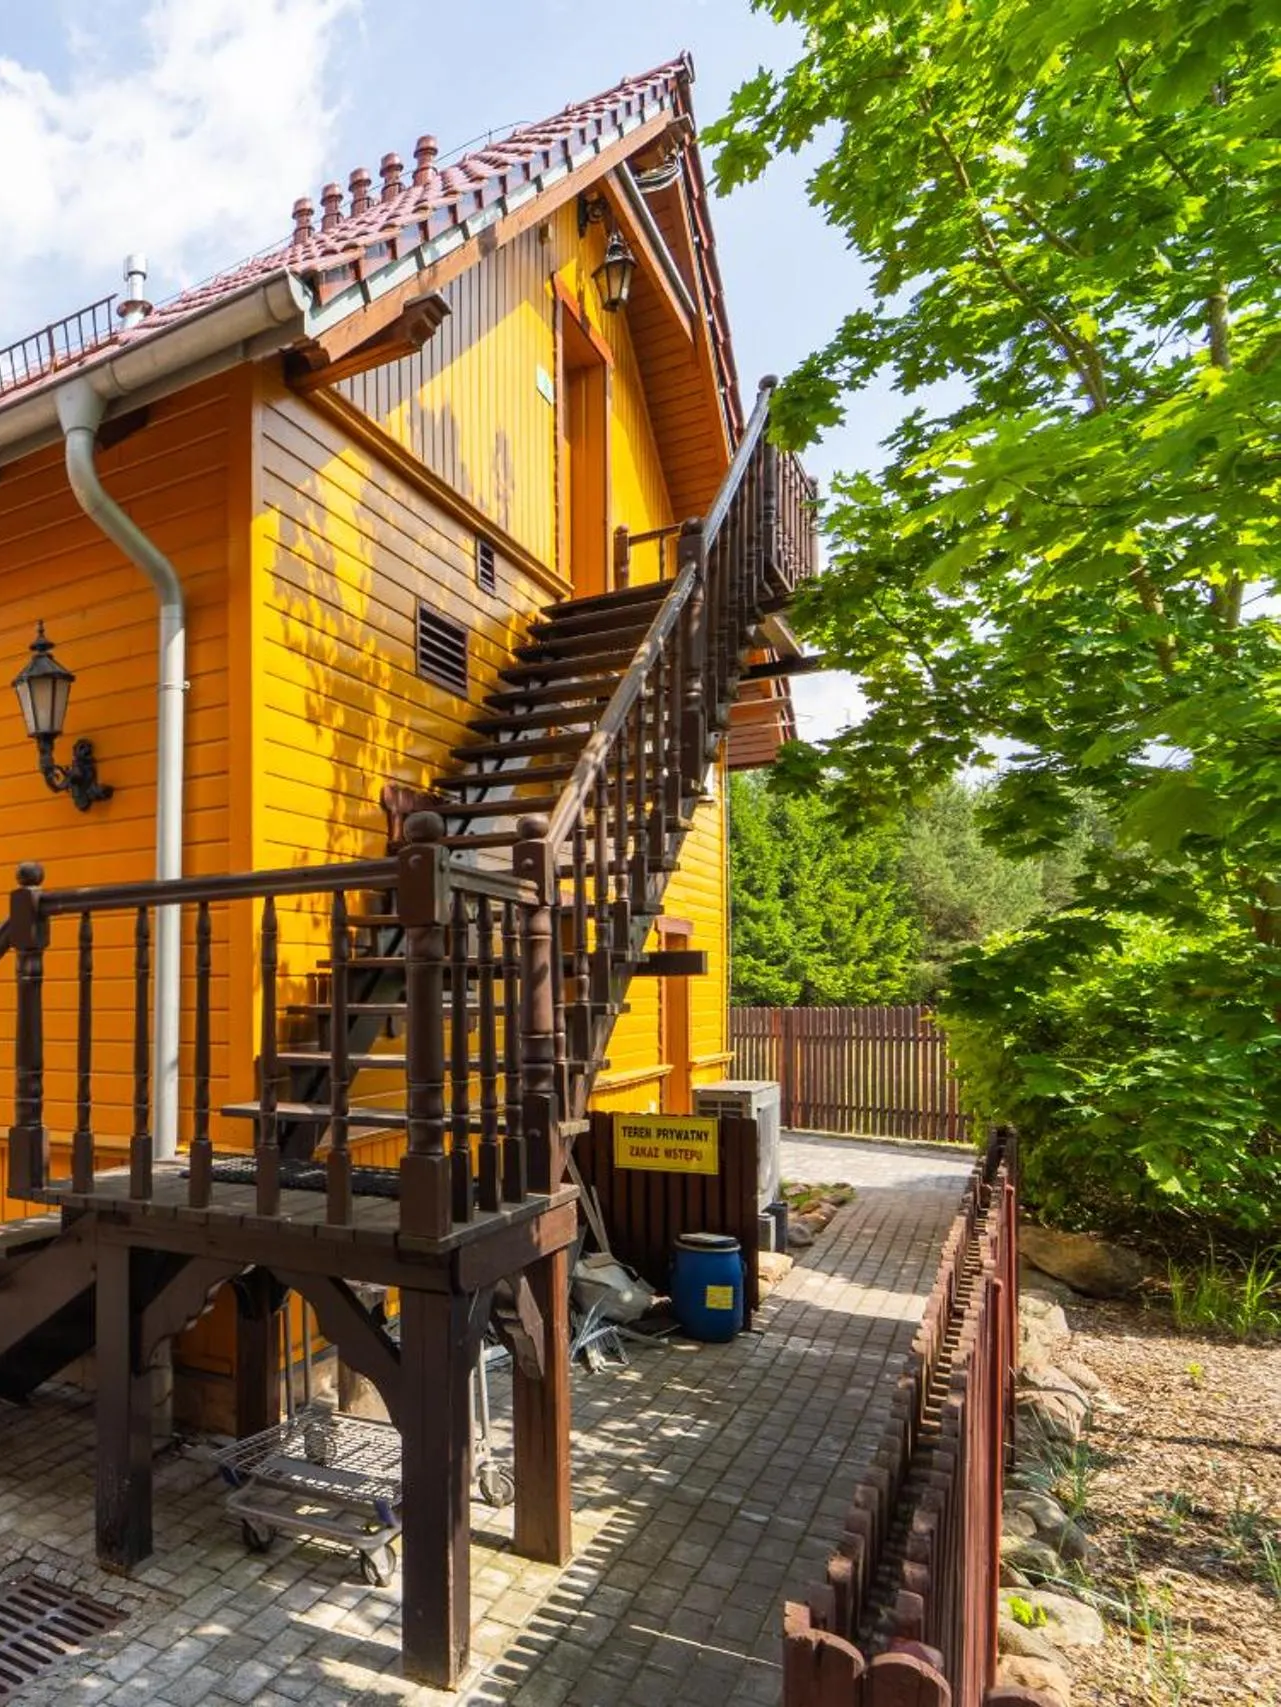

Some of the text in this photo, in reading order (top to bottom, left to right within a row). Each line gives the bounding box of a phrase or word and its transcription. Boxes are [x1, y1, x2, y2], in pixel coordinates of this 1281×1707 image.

[621, 1126, 710, 1142] TEREN PRYWATNY
[629, 1145, 659, 1159] ZAKAZ
